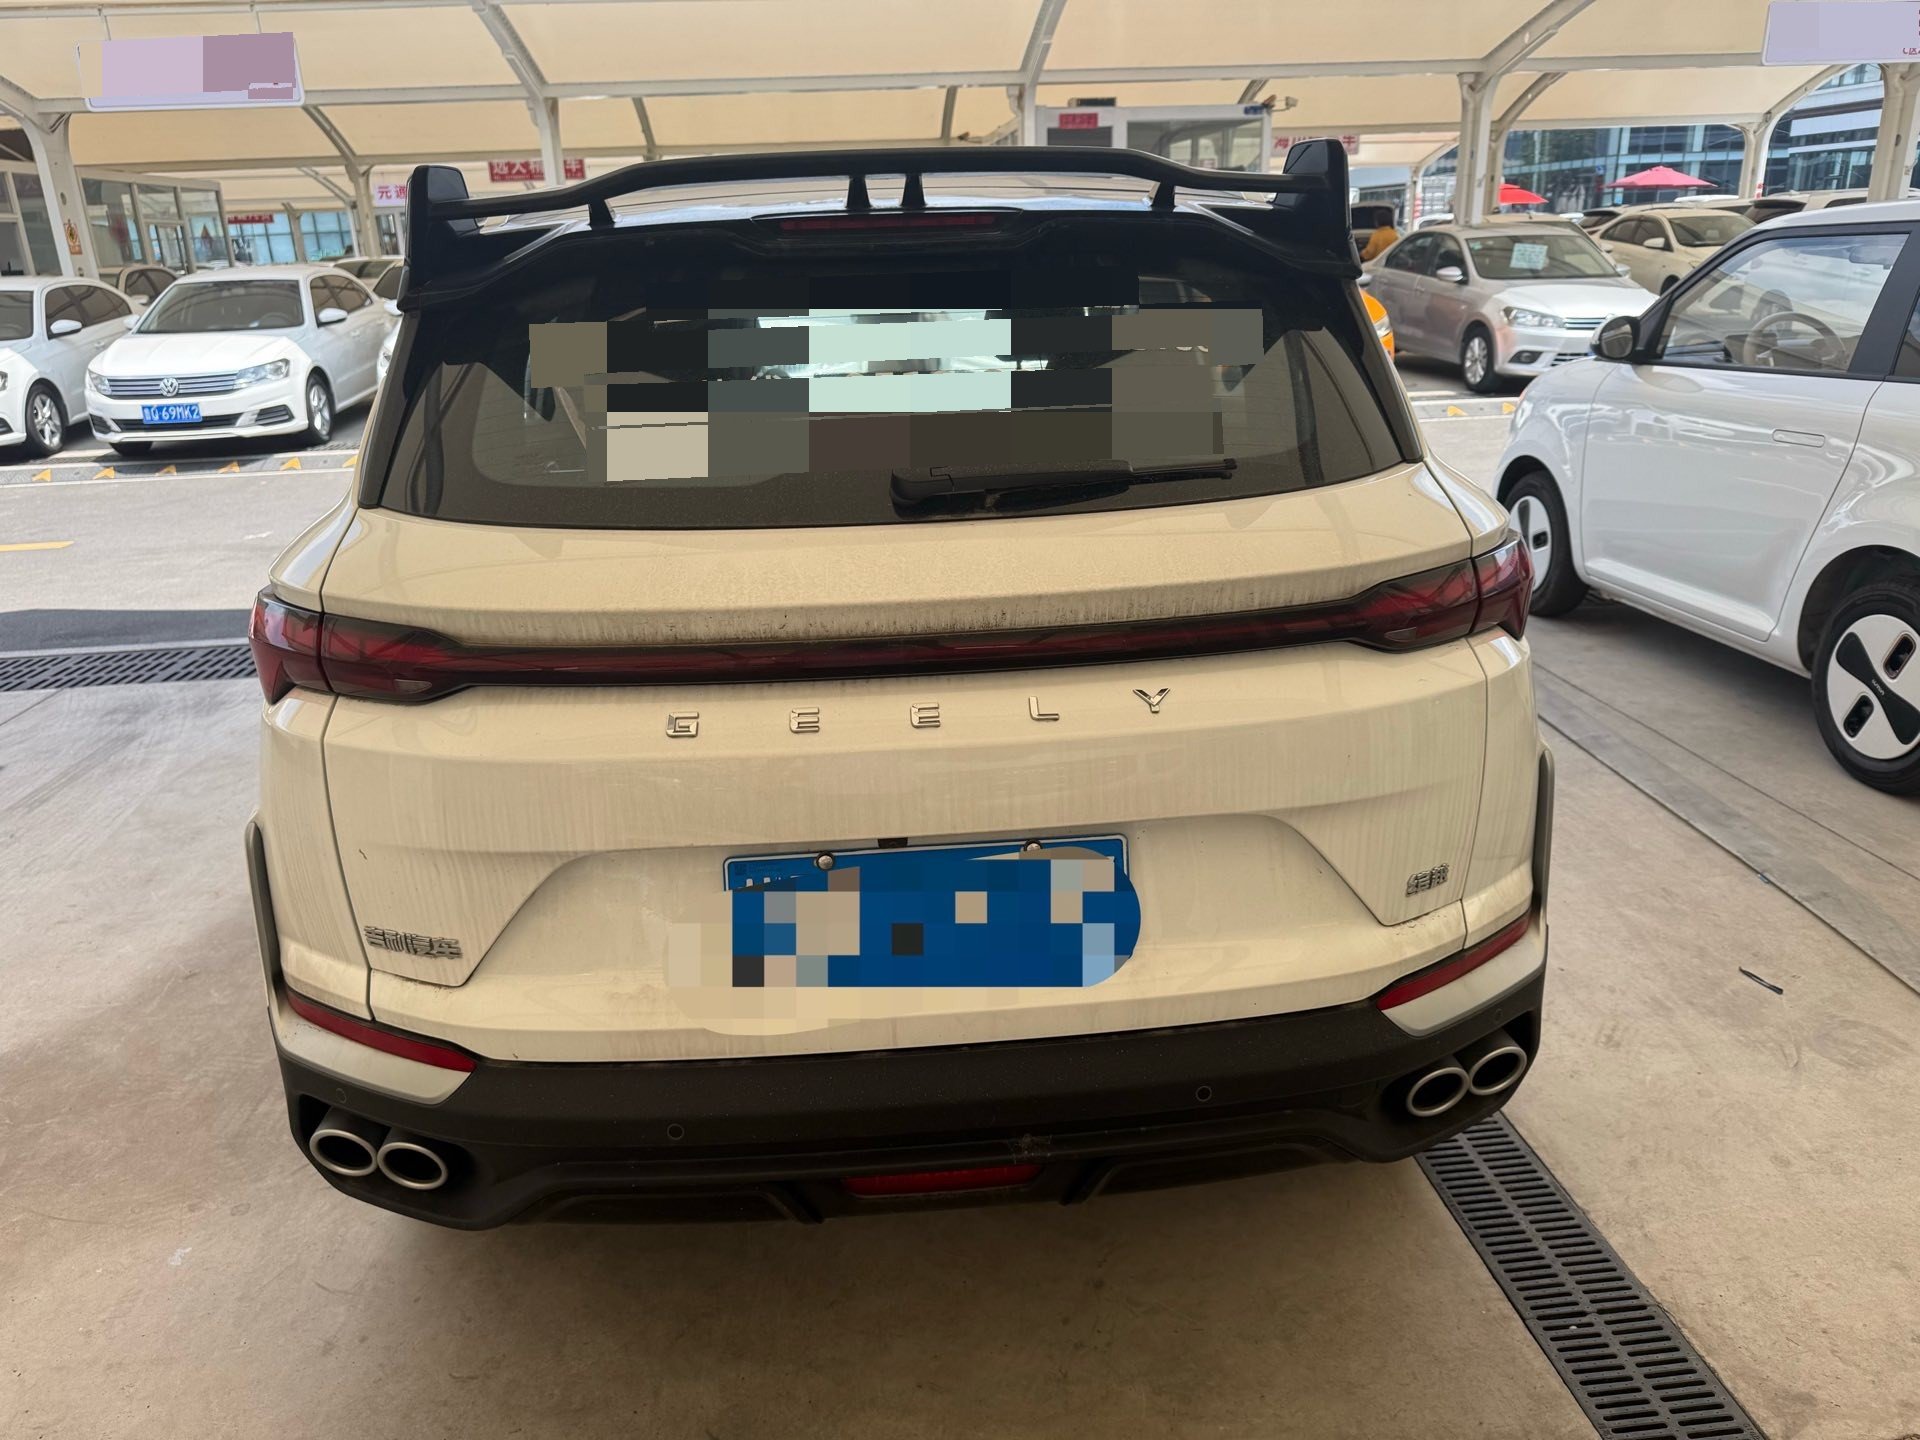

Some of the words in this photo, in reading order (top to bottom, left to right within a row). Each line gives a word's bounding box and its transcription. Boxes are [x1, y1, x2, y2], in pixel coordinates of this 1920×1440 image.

[665, 687, 1171, 738] GEELY
[364, 926, 463, 959] 吉利汽车
